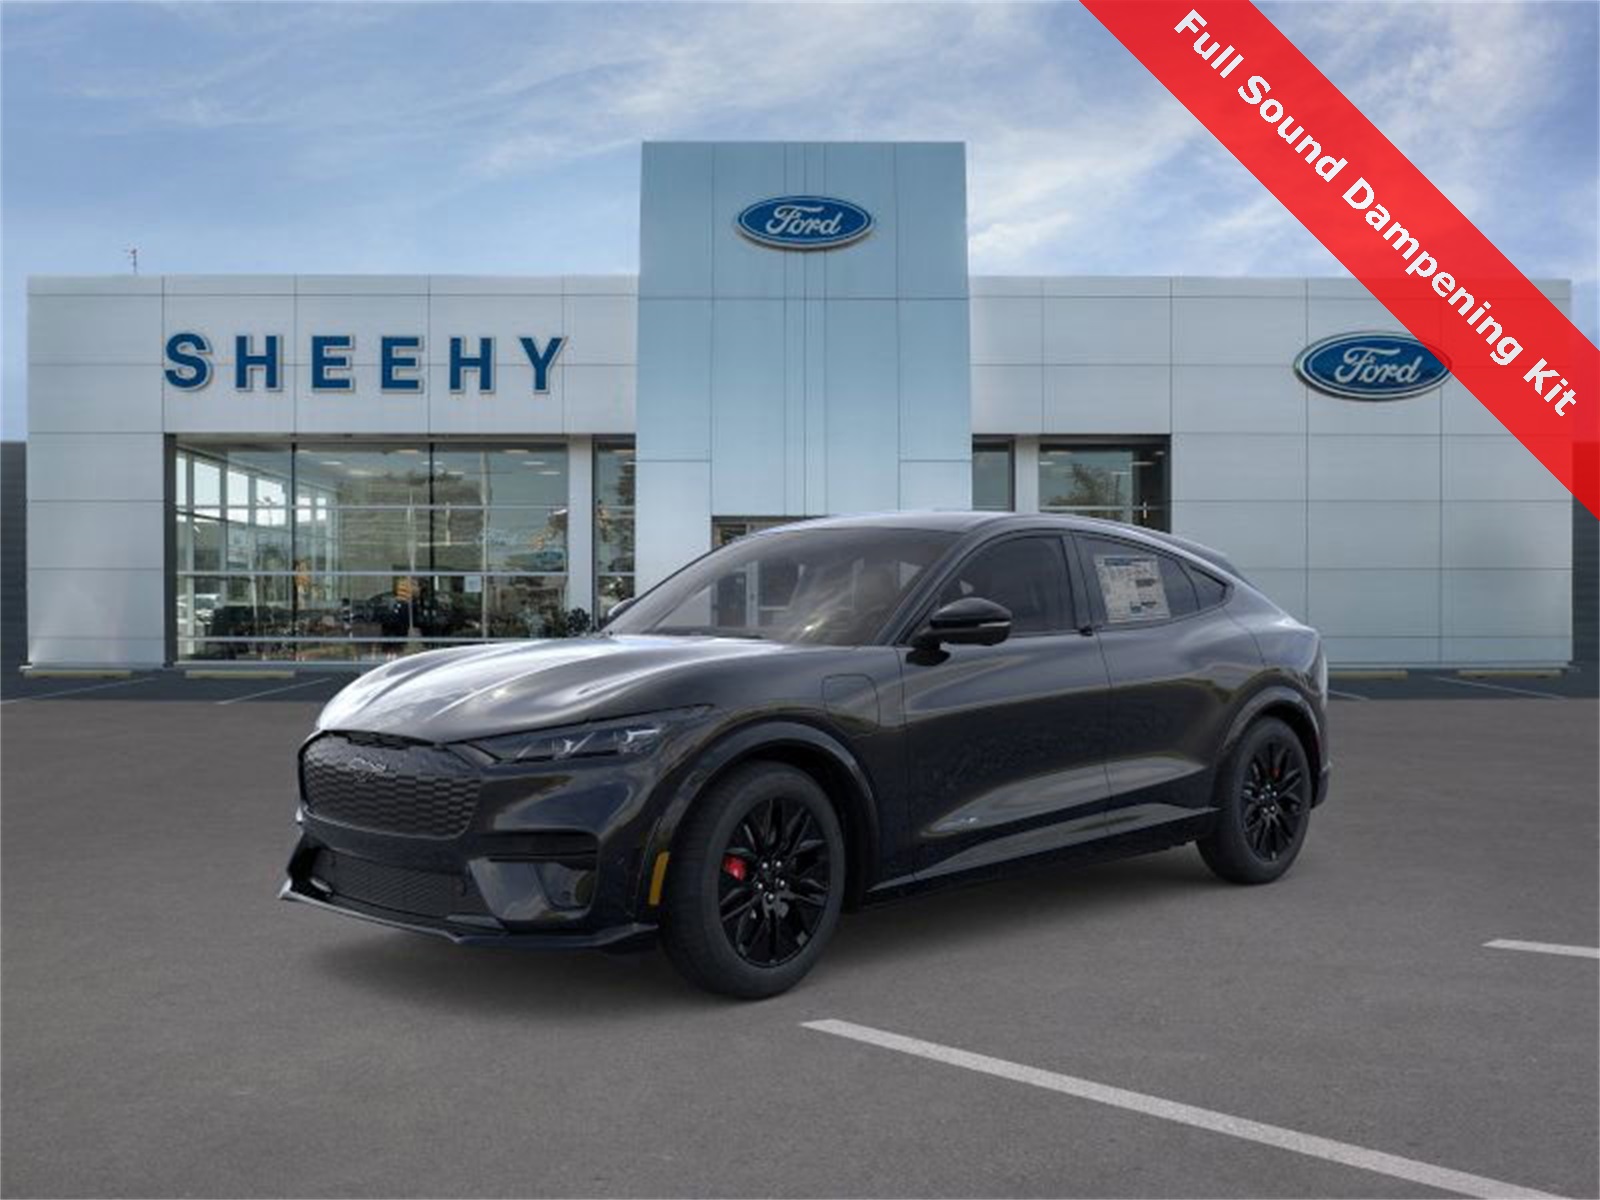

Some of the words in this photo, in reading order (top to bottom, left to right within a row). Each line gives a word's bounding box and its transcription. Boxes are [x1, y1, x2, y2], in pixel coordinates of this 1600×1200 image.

[765, 204, 843, 235] Ford
[164, 332, 567, 394] SHEEHY
[1333, 346, 1423, 383] Ford
